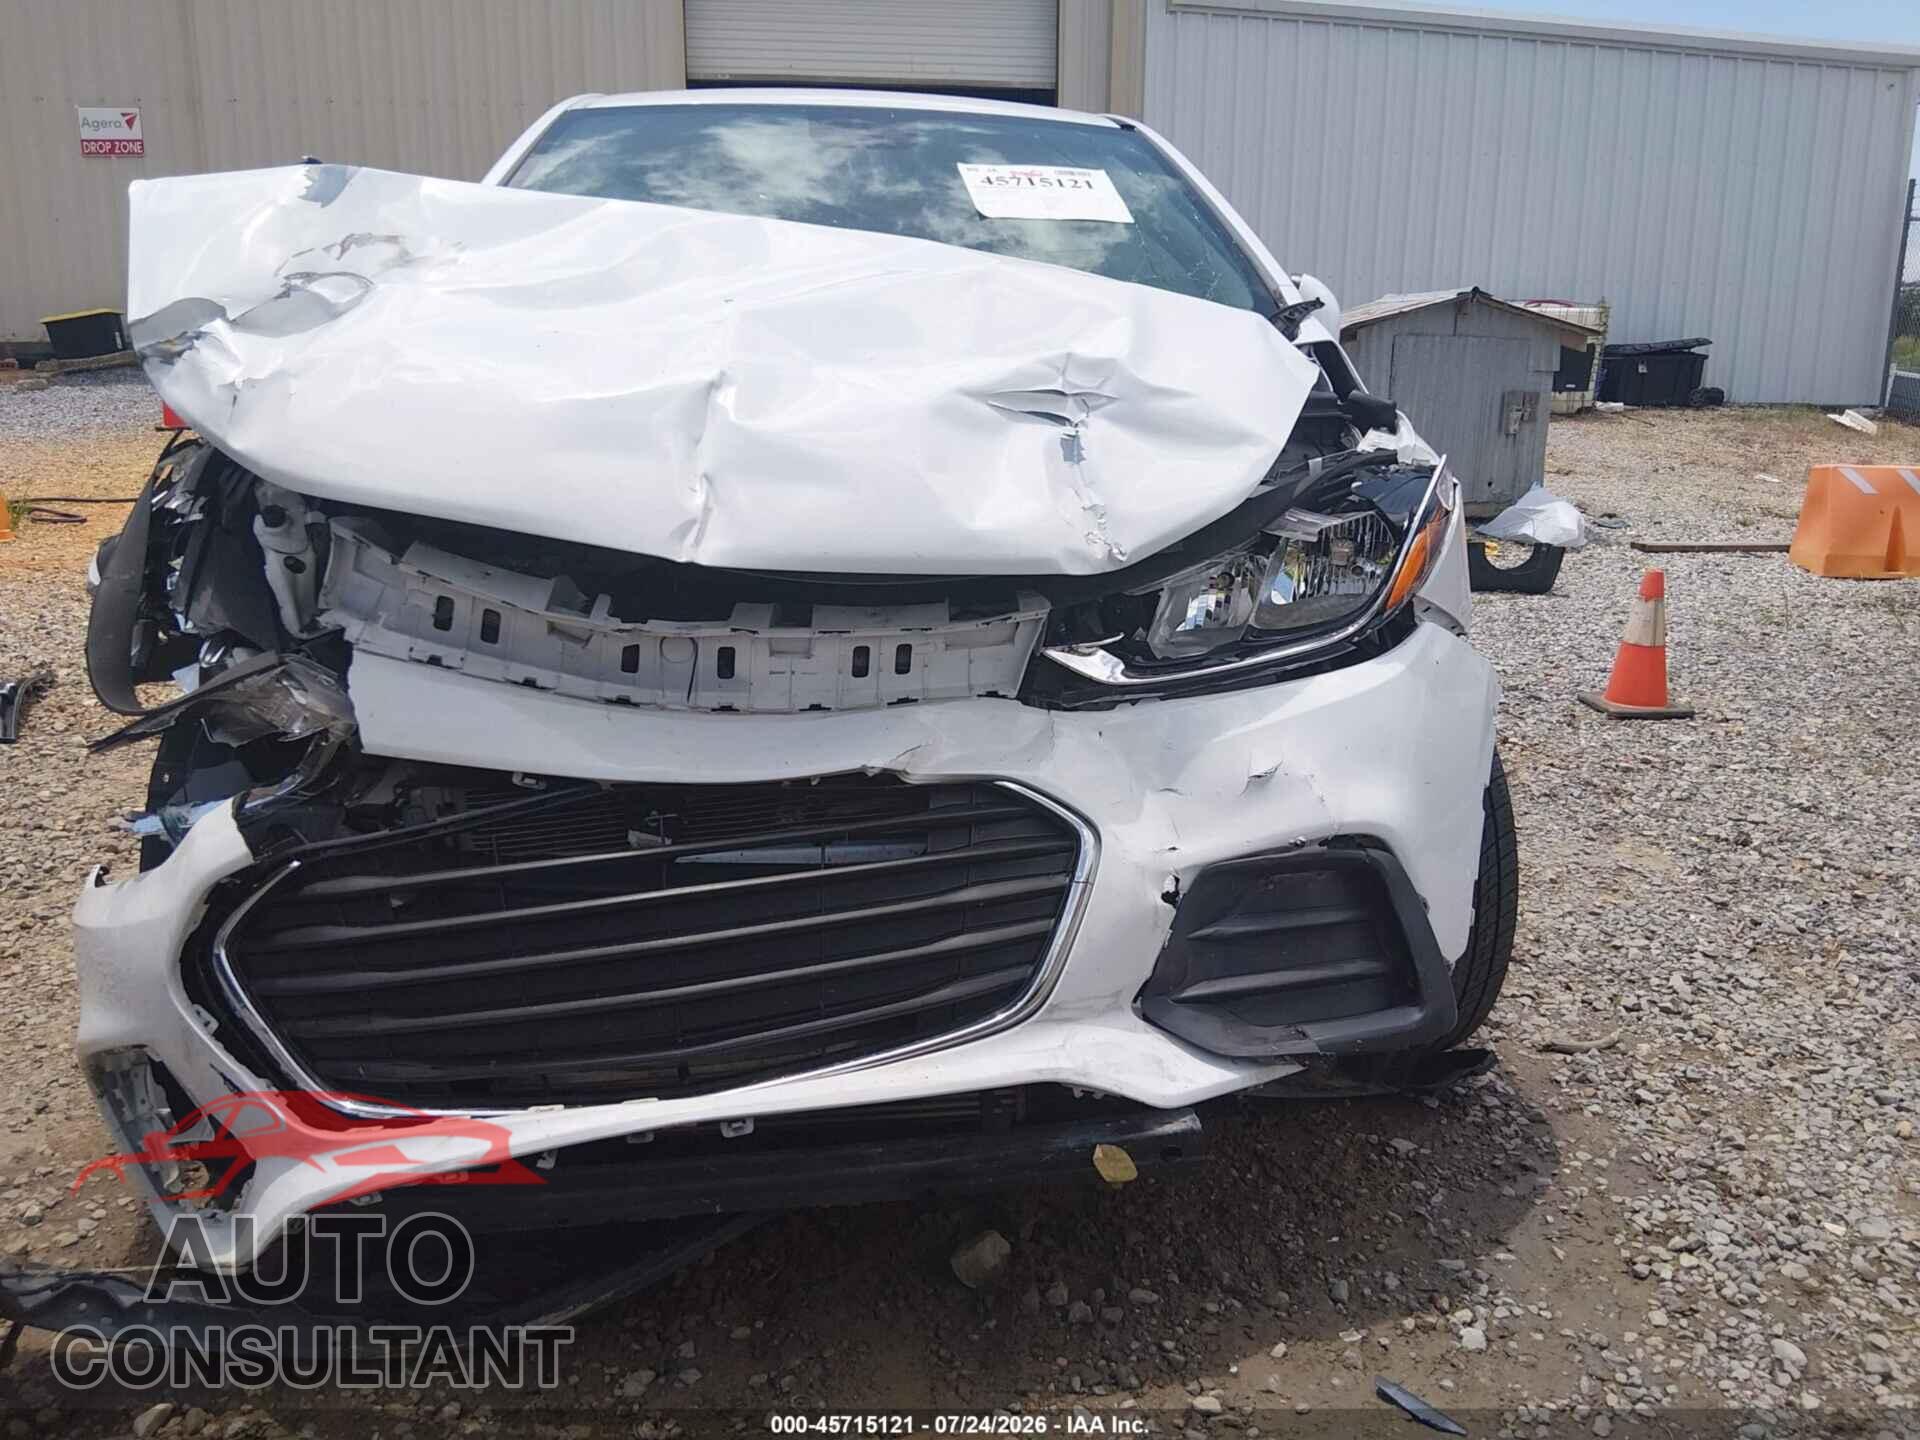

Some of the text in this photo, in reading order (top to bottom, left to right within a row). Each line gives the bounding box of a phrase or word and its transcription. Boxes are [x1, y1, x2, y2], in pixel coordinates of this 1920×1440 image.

[81, 116, 122, 131] Agero
[83, 141, 143, 153] DROP ZONE
[980, 175, 1095, 190] 45715121
